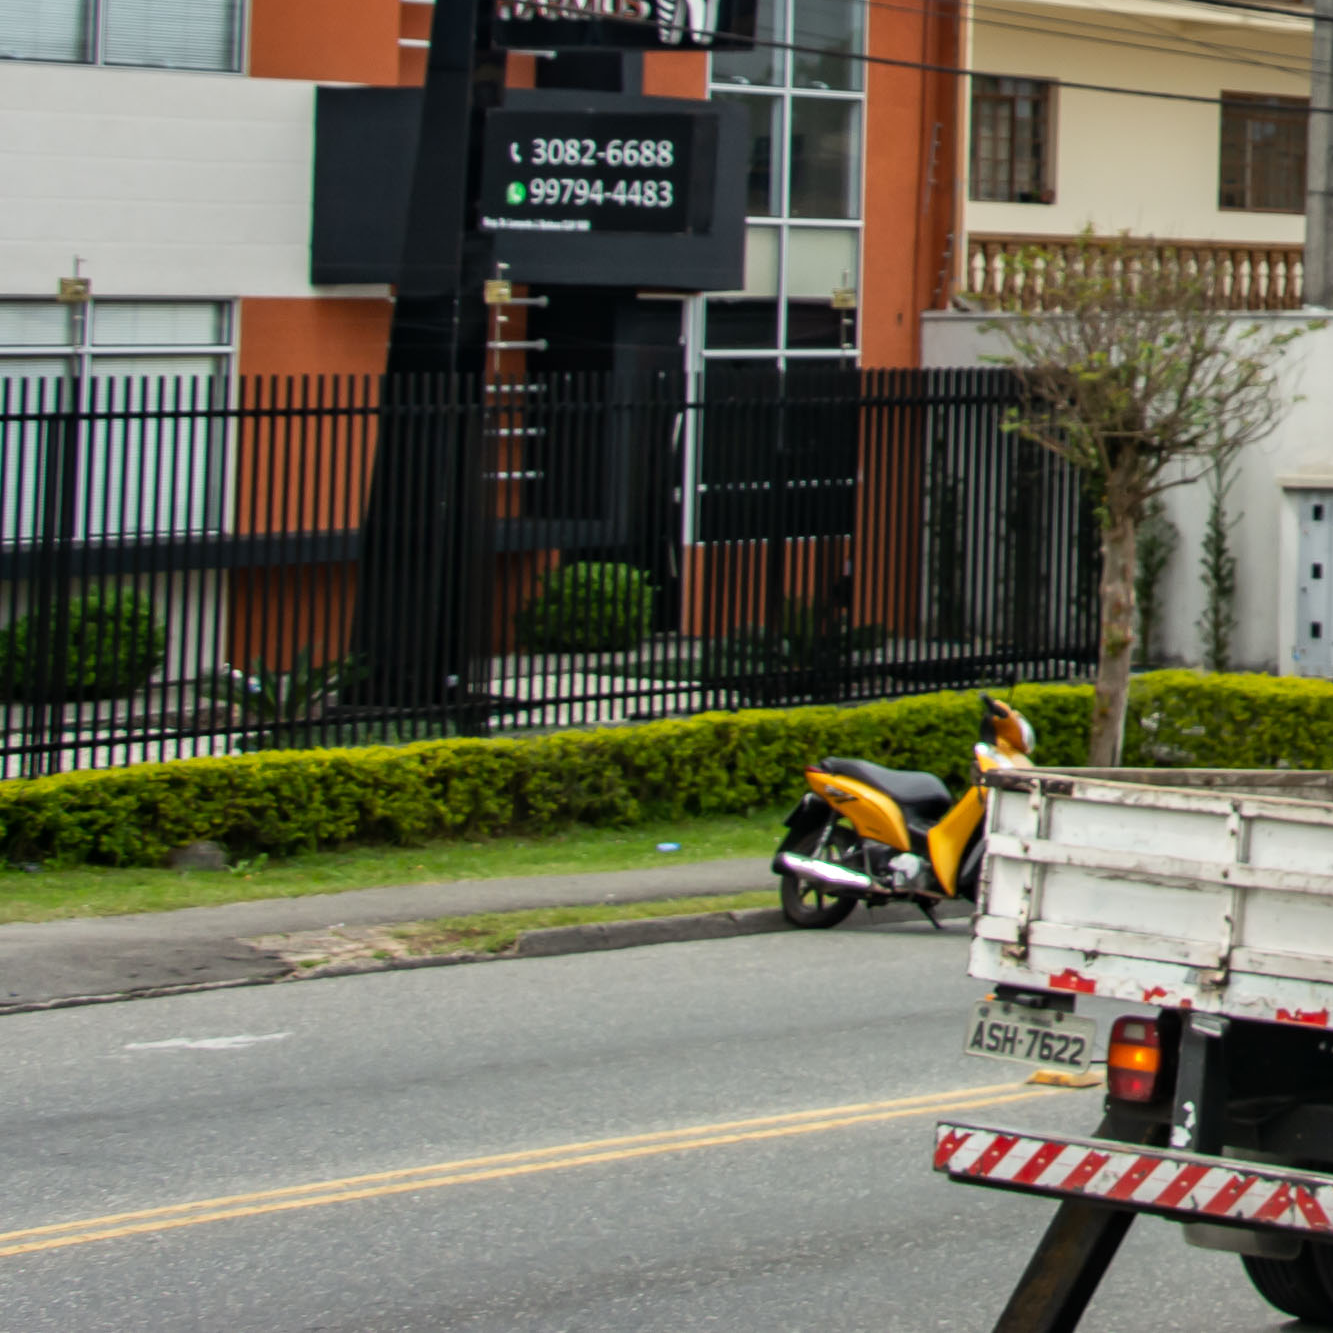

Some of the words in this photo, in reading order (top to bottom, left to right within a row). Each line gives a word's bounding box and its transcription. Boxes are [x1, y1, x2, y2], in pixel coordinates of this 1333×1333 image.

[531, 138, 674, 167] 3082-6688
[529, 178, 674, 207] 99794-4483
[970, 1020, 1086, 1066] ASH-7622
